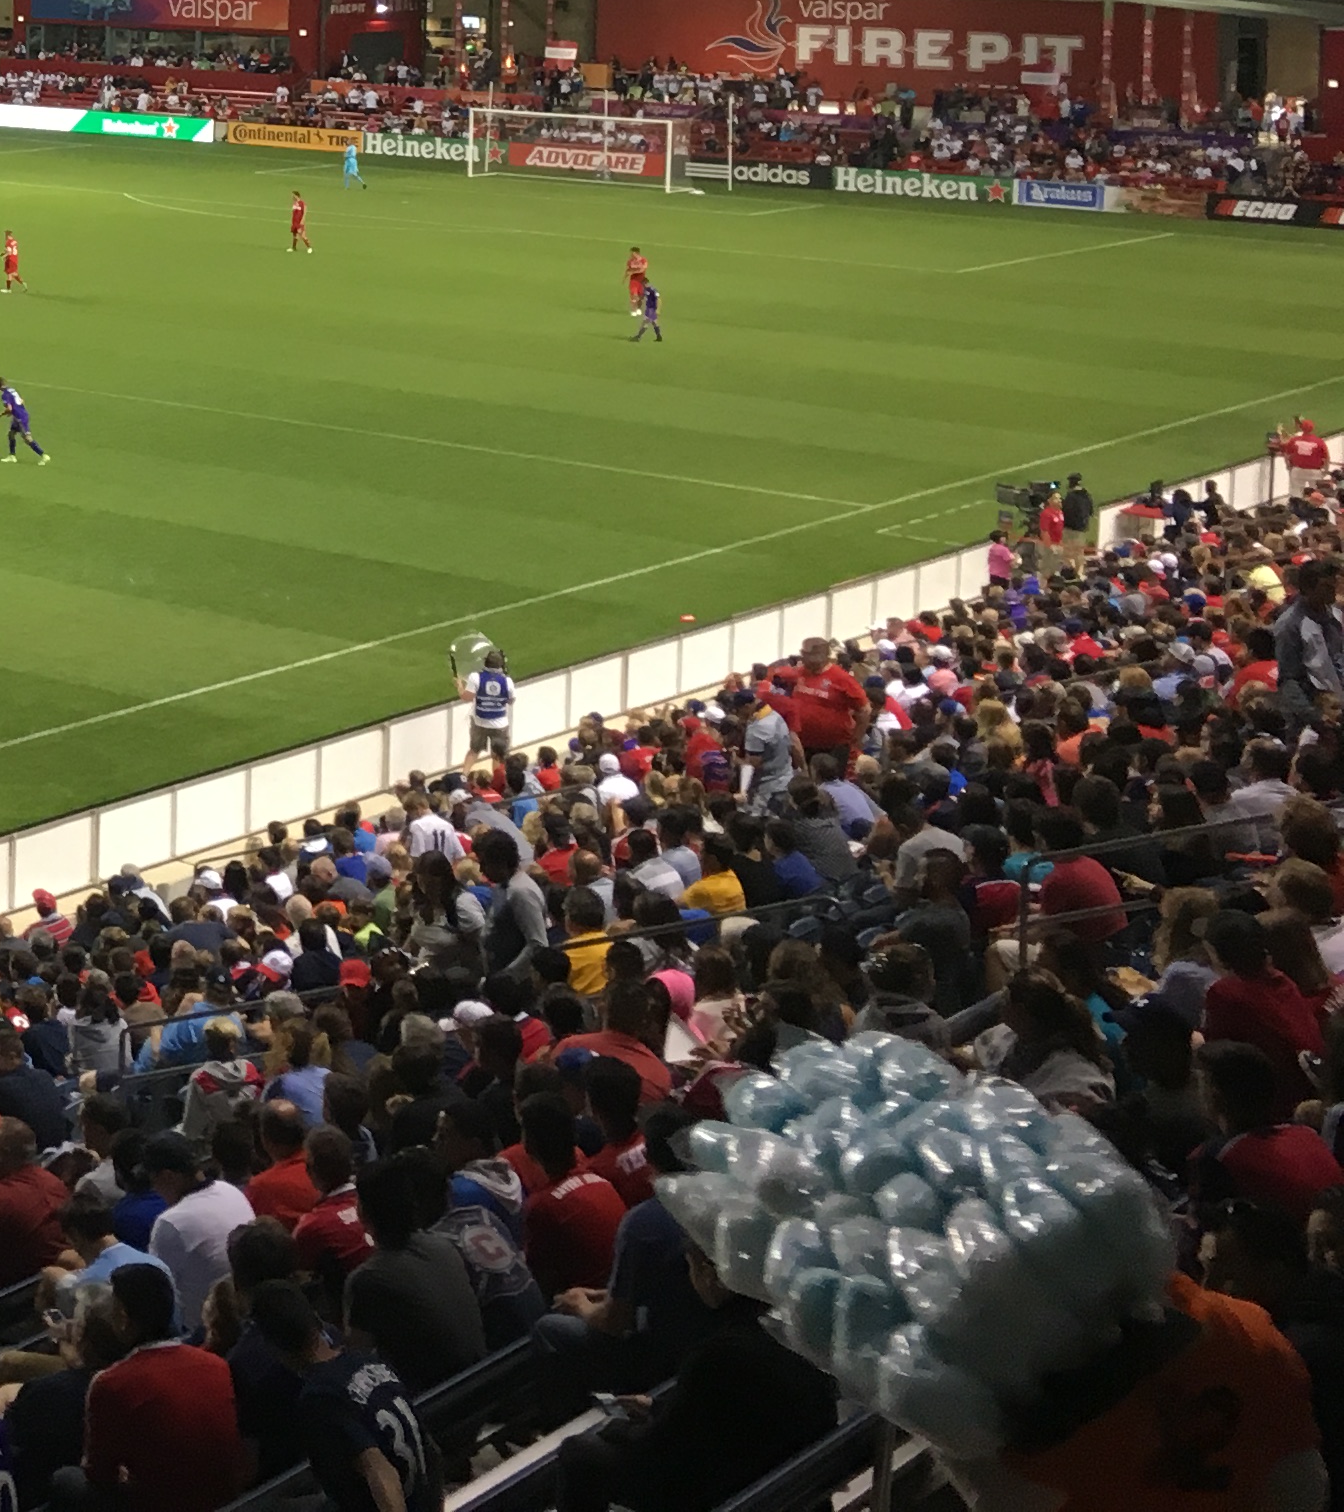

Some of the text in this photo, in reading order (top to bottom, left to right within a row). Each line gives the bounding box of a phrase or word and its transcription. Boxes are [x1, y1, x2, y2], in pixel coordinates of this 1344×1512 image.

[233, 122, 312, 144] Continental
[365, 133, 480, 162] Heineken
[526, 147, 646, 174] ADVOCARE
[733, 164, 810, 185] adidas
[835, 166, 978, 201] Heineken
[1232, 200, 1298, 220] ECHO
[433, 830, 445, 850] 11
